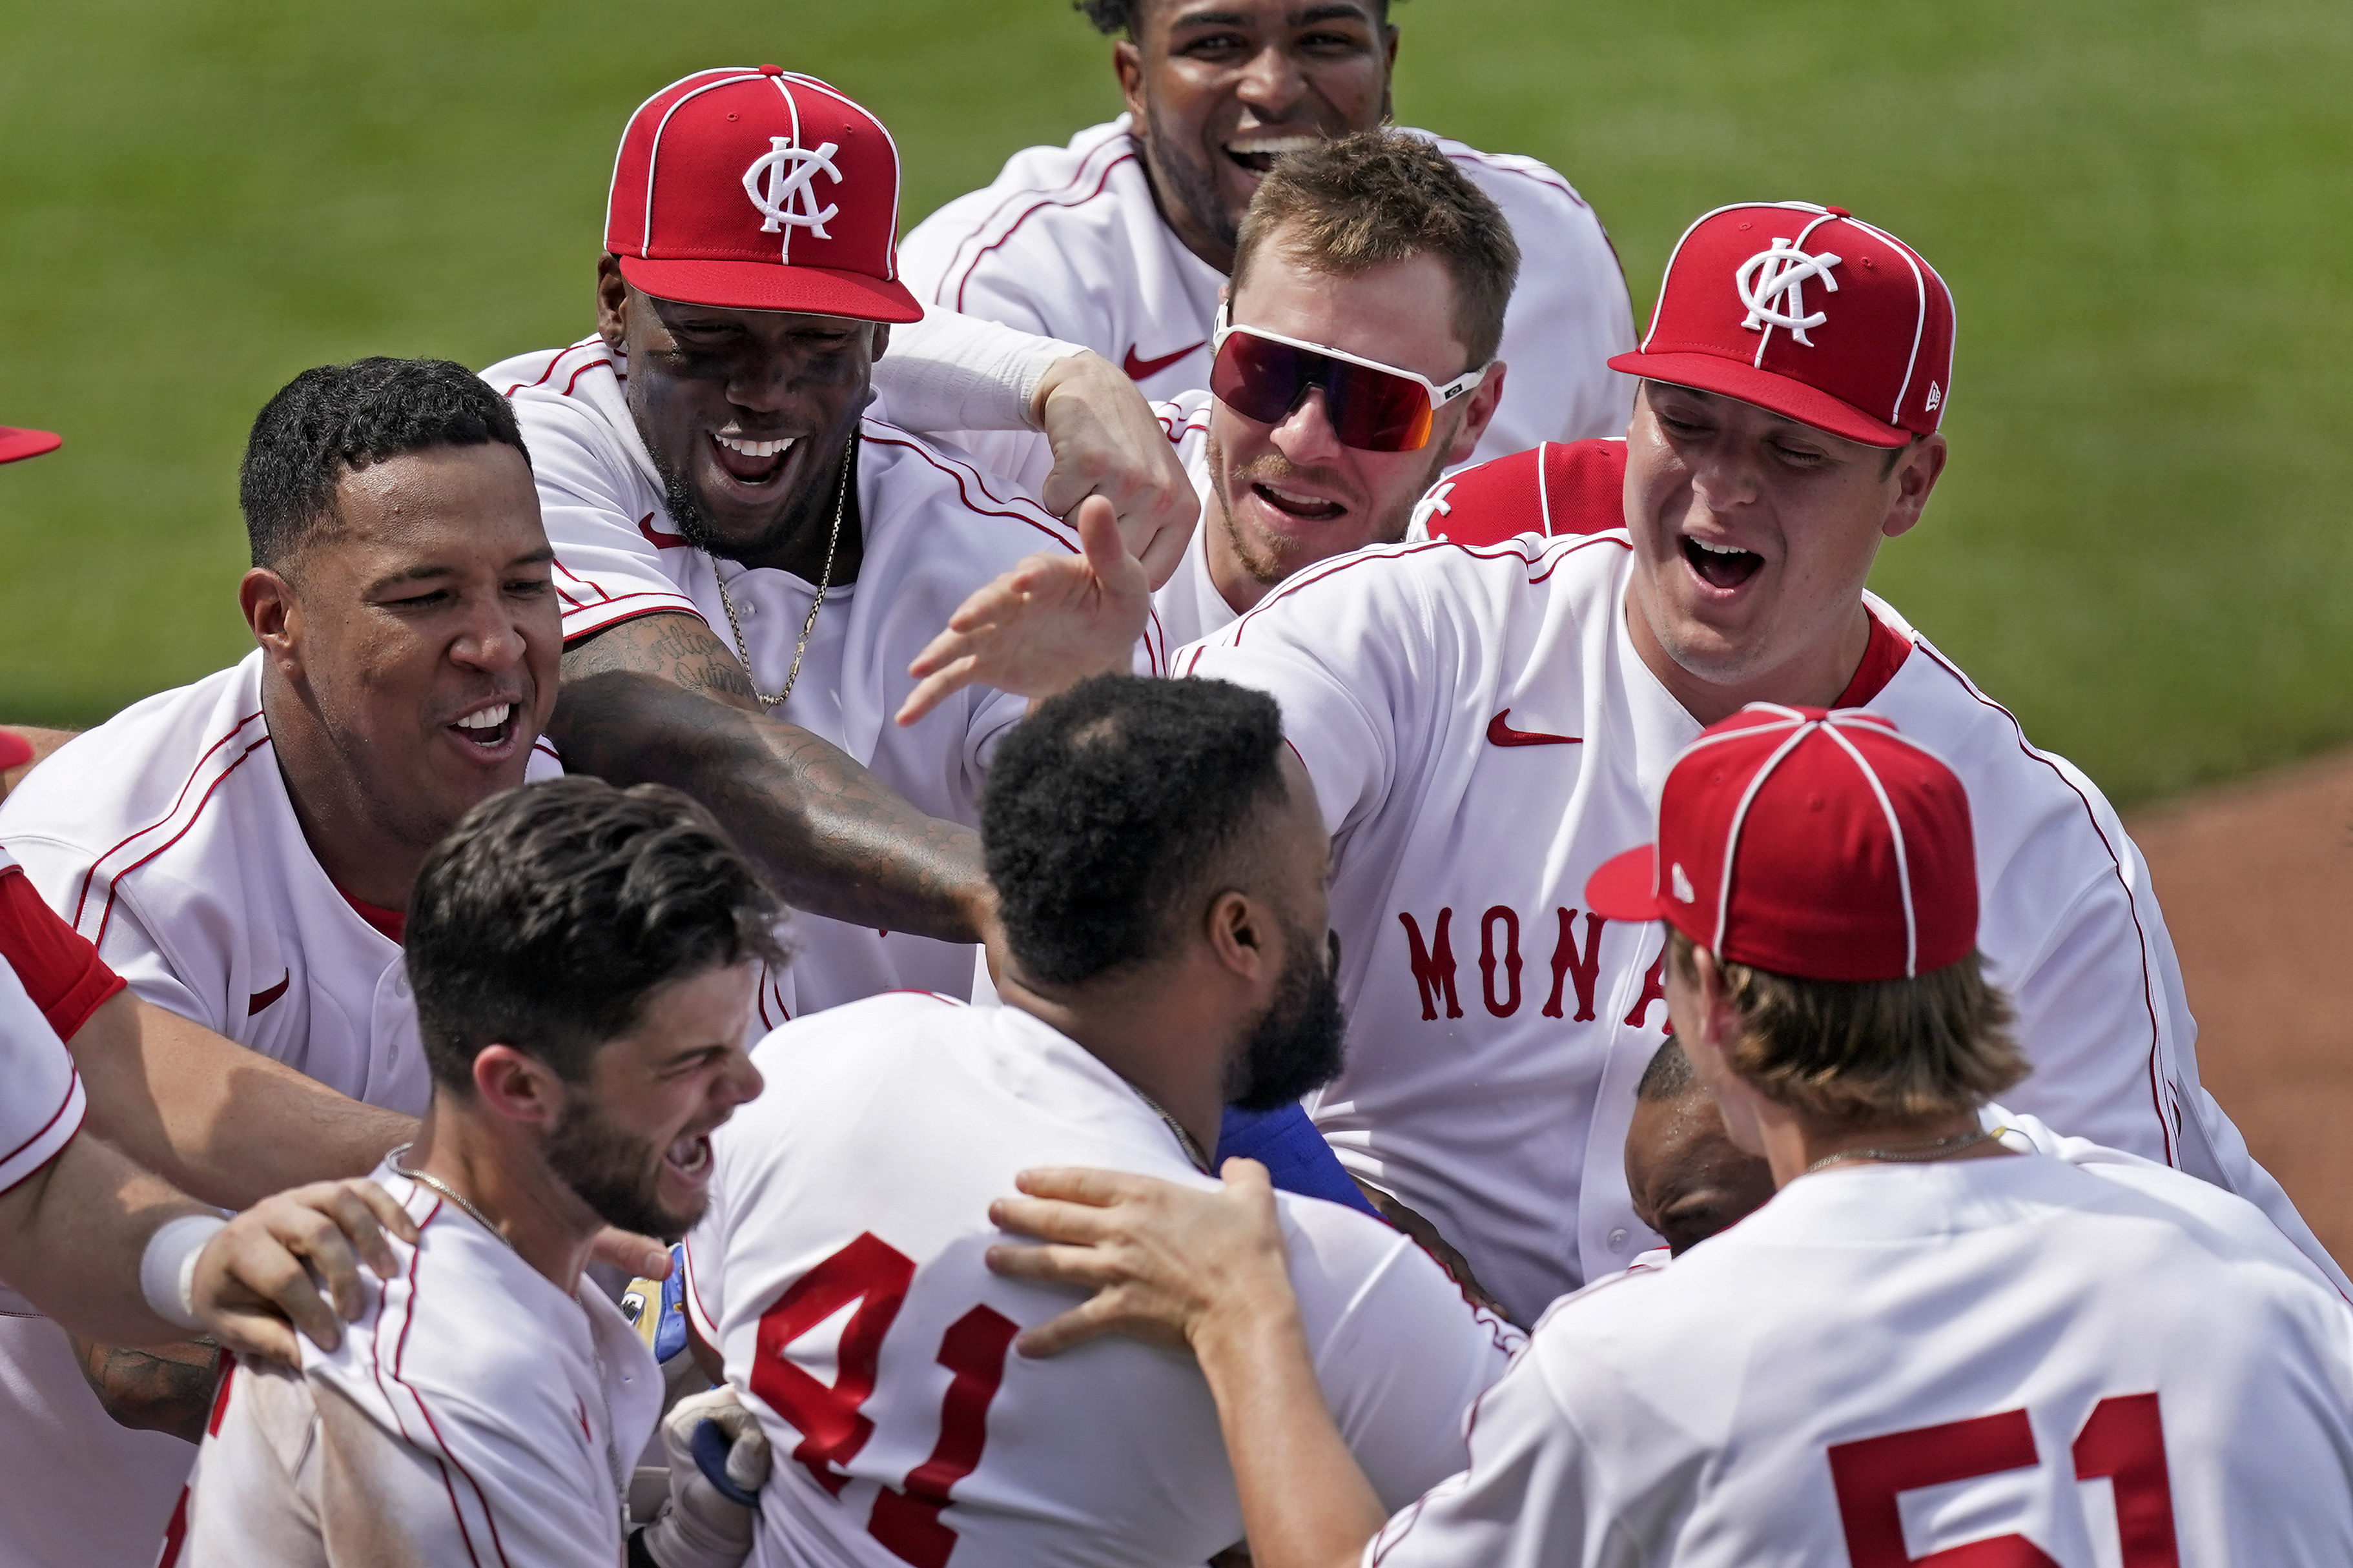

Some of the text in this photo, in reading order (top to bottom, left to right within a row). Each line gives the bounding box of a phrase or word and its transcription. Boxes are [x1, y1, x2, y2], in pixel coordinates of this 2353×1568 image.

[742, 136, 843, 240] KC
[1735, 236, 1842, 348] KC
[749, 1230, 1020, 1568] 41
